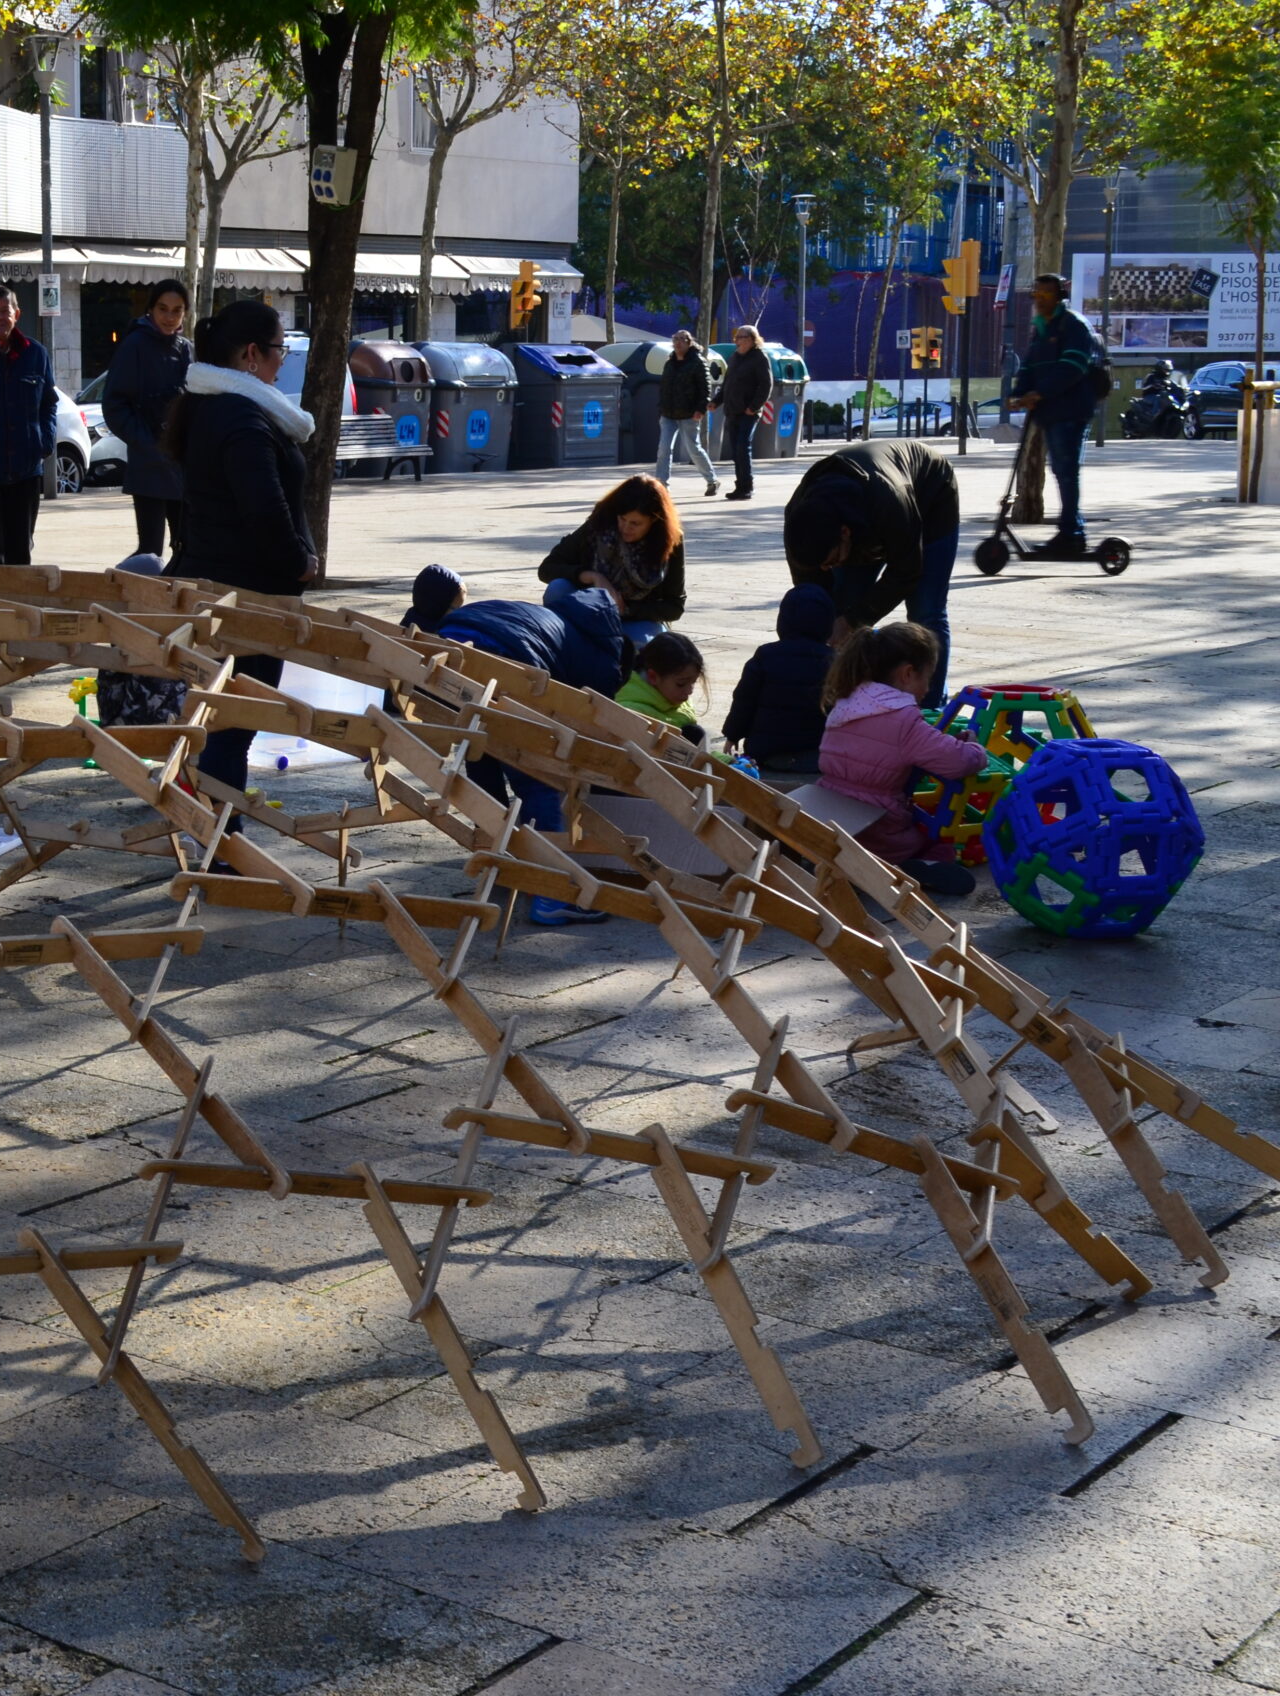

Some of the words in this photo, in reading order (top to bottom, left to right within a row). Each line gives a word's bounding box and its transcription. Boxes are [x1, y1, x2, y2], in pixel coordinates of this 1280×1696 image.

[0, 264, 33, 277] AMBLA
[1222, 262, 1245, 274] ELS
[355, 275, 400, 288] ERVECERIA
[1221, 276, 1258, 288] PISOS
[1218, 333, 1235, 341] 937
[1238, 333, 1255, 341] 077
